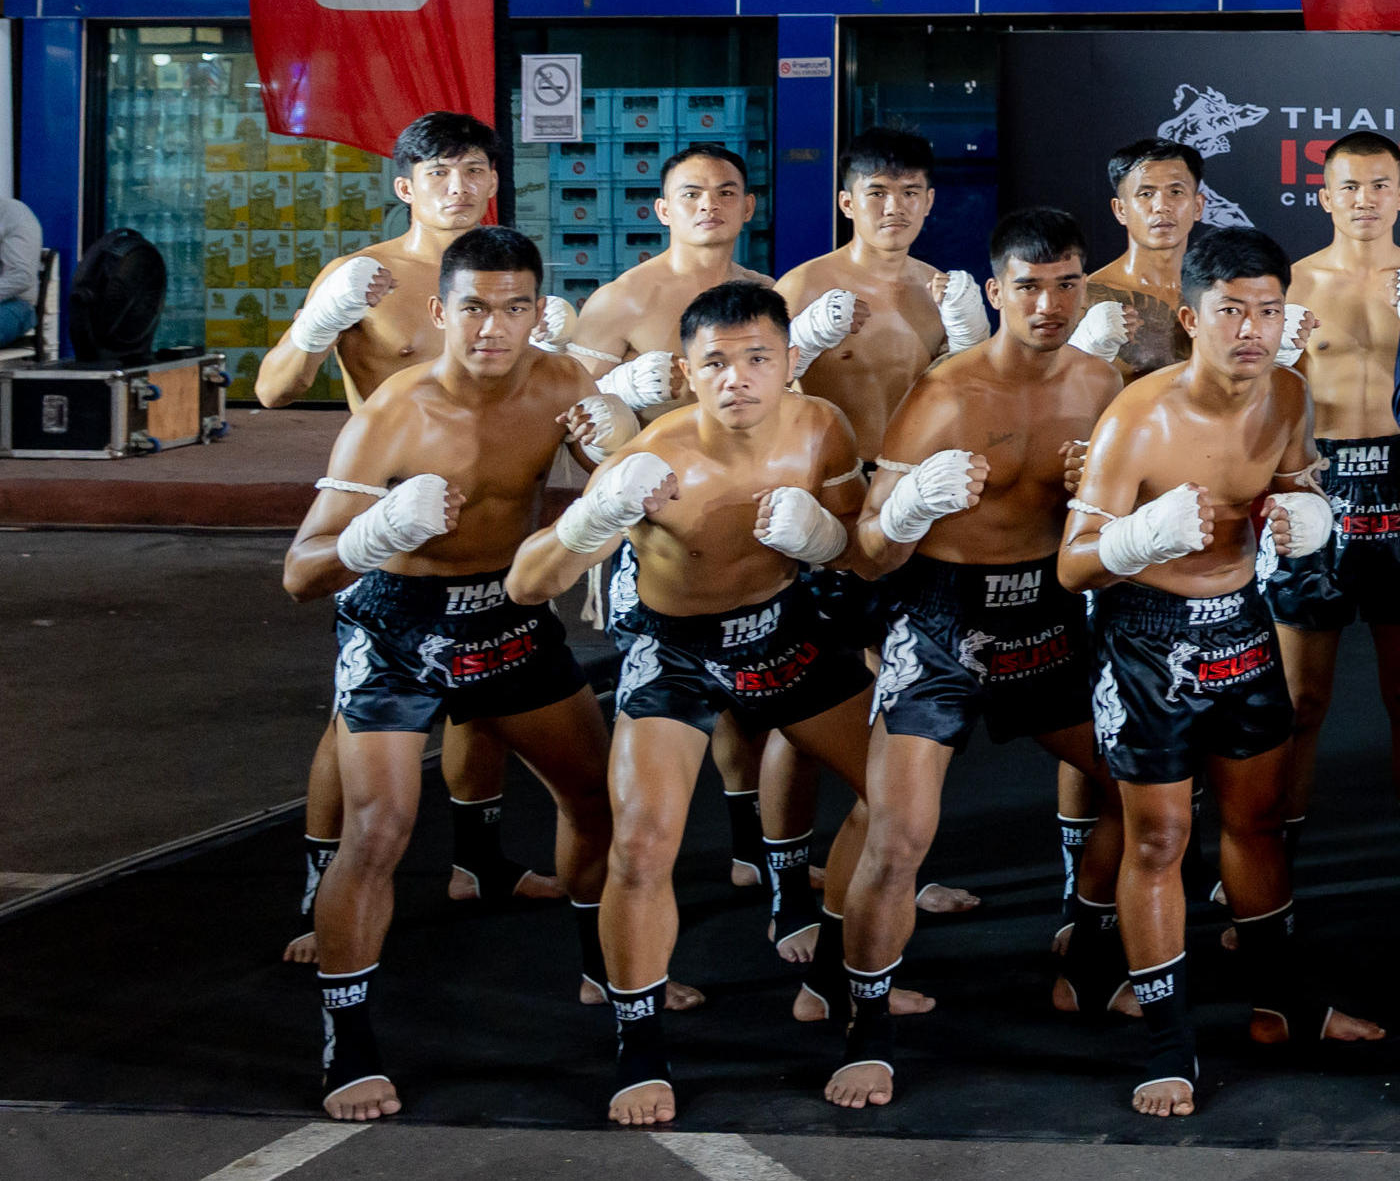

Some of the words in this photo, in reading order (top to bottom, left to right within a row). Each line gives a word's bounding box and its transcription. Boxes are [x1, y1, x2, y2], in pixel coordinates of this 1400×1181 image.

[1336, 446, 1390, 462] THAI
[1337, 461, 1389, 472] FIGHT
[985, 570, 1042, 593] THAI
[720, 602, 781, 635] THAI
[322, 981, 368, 1000] THAI
[613, 995, 655, 1014] THAI
